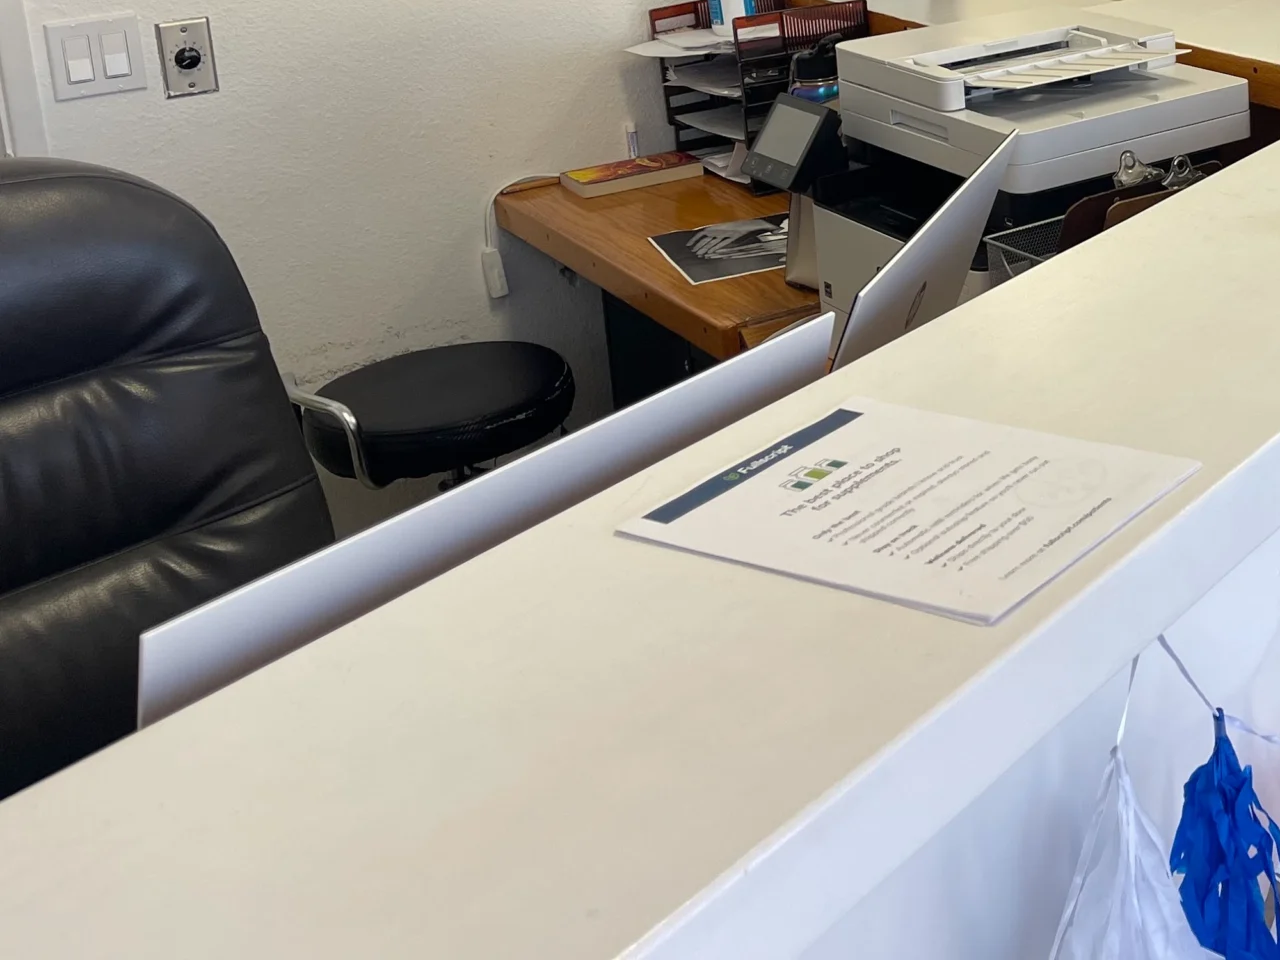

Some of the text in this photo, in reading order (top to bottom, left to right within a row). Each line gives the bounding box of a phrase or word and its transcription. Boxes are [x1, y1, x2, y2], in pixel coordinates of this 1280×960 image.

[737, 444, 793, 475] Fullscript
[779, 447, 901, 517] The best place to shop
[811, 500, 831, 511] for
